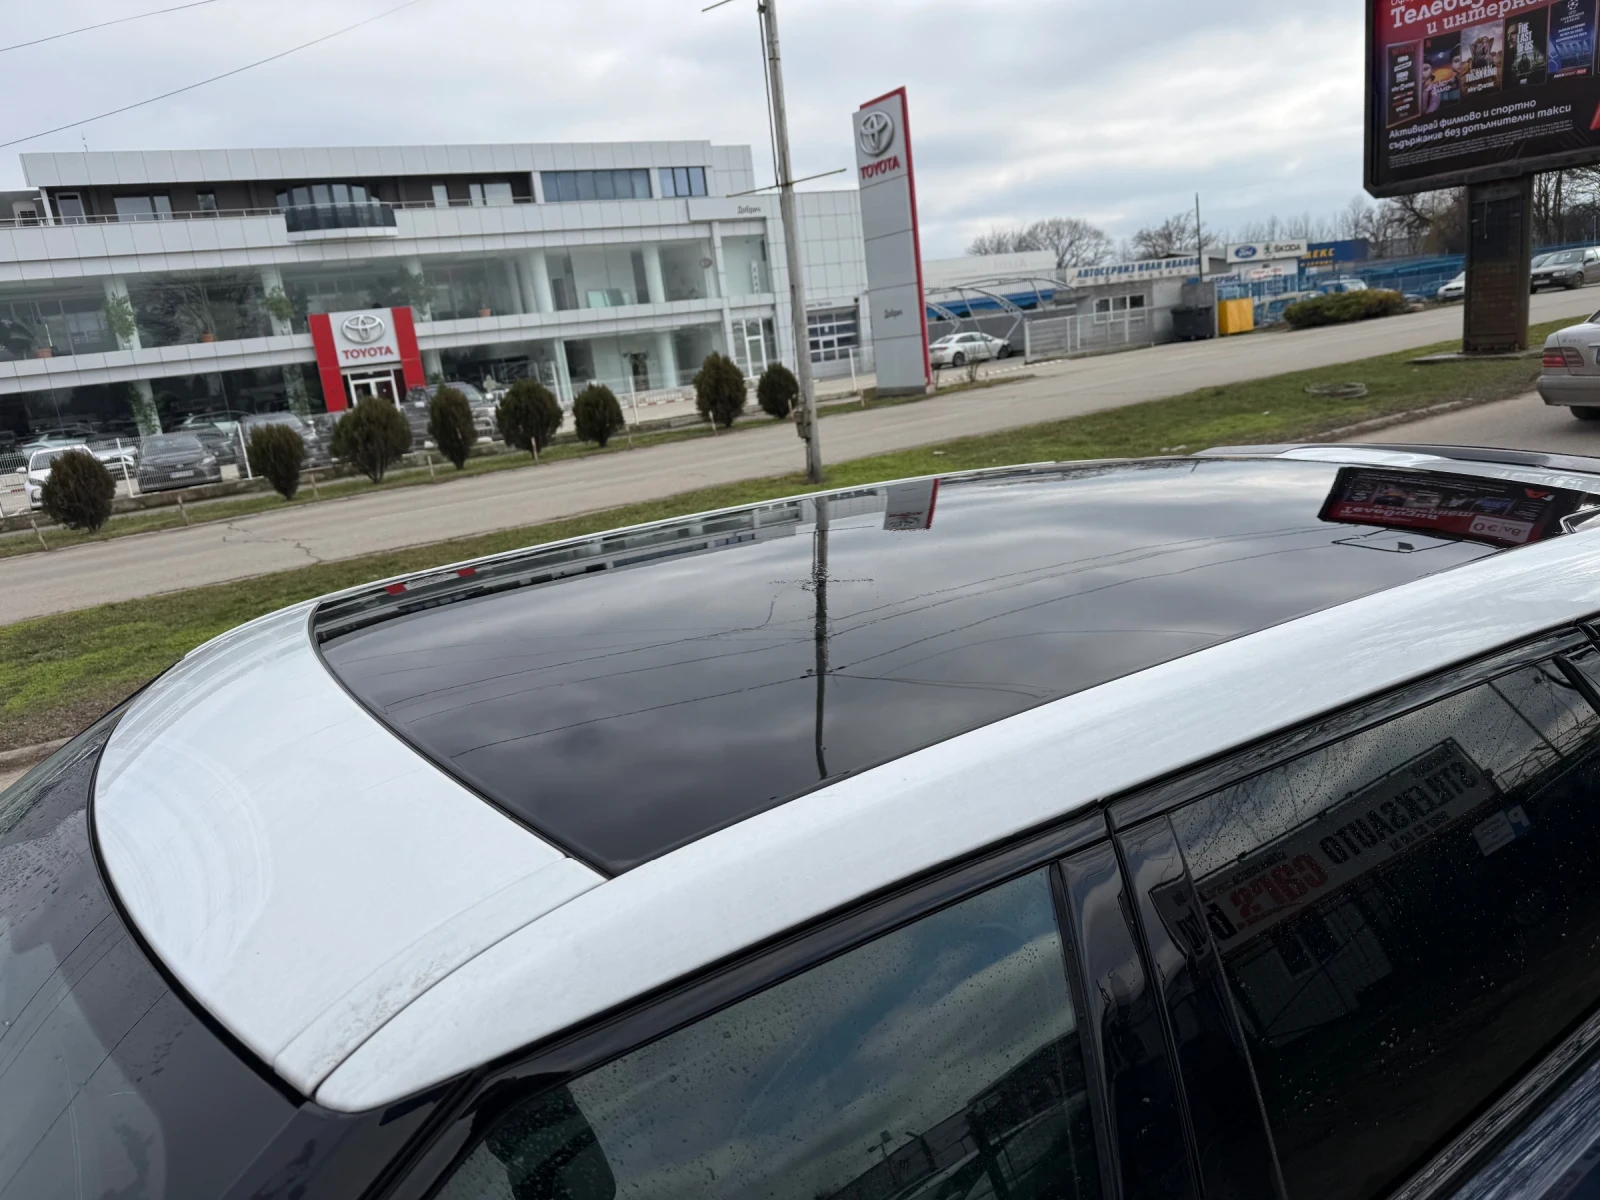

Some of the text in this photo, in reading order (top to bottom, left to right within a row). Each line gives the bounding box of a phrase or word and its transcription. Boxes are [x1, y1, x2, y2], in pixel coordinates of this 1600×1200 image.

[1517, 31, 1532, 42] LAST
[1518, 22, 1530, 34] THE
[1389, 99, 1537, 139] Активирай филмово и спортно
[1389, 131, 1443, 150] съдържание
[1444, 127, 1461, 138] без
[1462, 111, 1535, 136] допълнителни
[1537, 104, 1572, 118] такси
[860, 156, 901, 180] TOYOTA
[1077, 264, 1136, 278] АВТОСЕРВИЗ
[1138, 261, 1163, 272] ИВАН
[342, 346, 394, 360] TOYOTA
